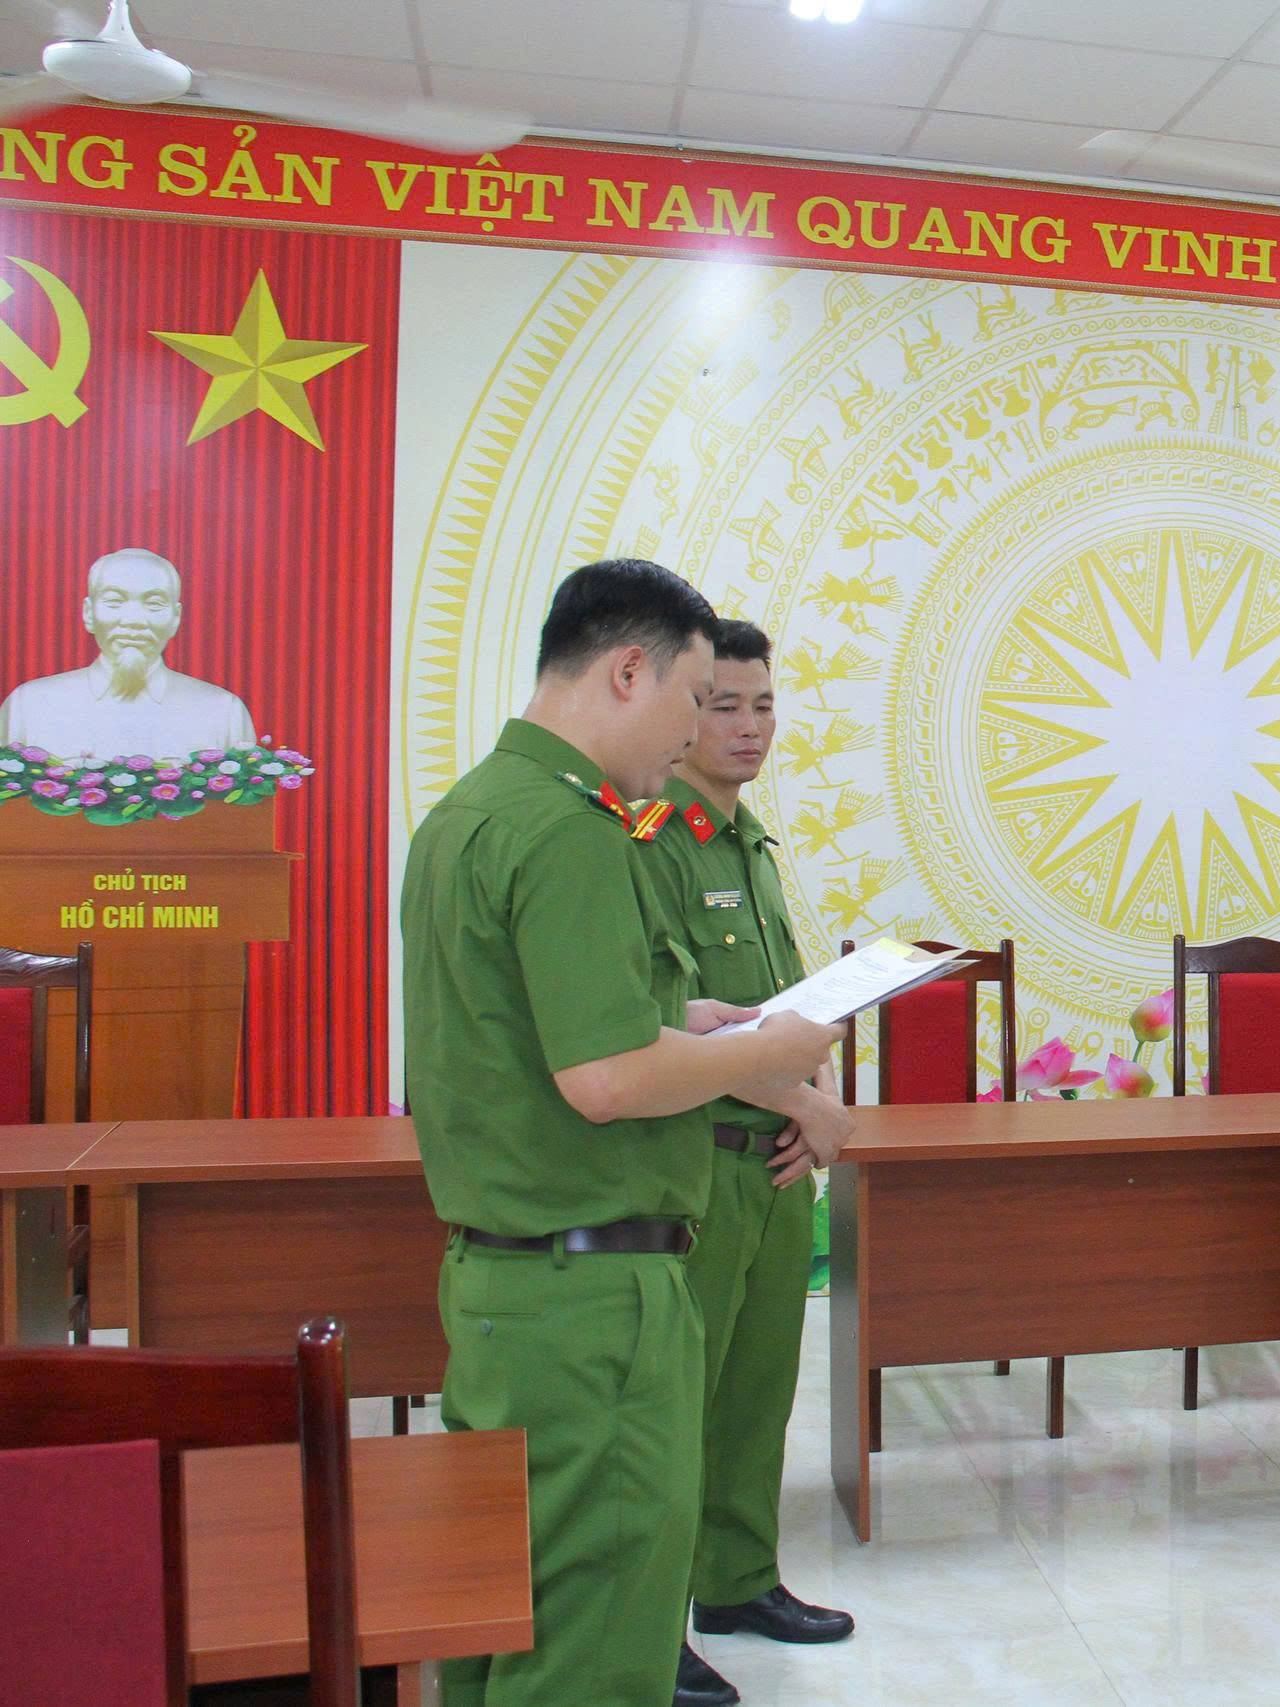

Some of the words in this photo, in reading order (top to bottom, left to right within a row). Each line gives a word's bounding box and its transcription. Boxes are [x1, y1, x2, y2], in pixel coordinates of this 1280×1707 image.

[0, 127, 133, 190] NG
[158, 124, 340, 206] SẢN
[366, 153, 564, 232] VIỆT
[588, 179, 775, 239] NAM
[797, 196, 1072, 264] QUANG
[1093, 223, 1277, 283] VINH
[93, 868, 136, 892] CHỦ
[141, 873, 188, 894] TỊCH
[60, 899, 96, 929] HỒ
[103, 902, 146, 929] CHÍ
[152, 905, 220, 929] MINH
